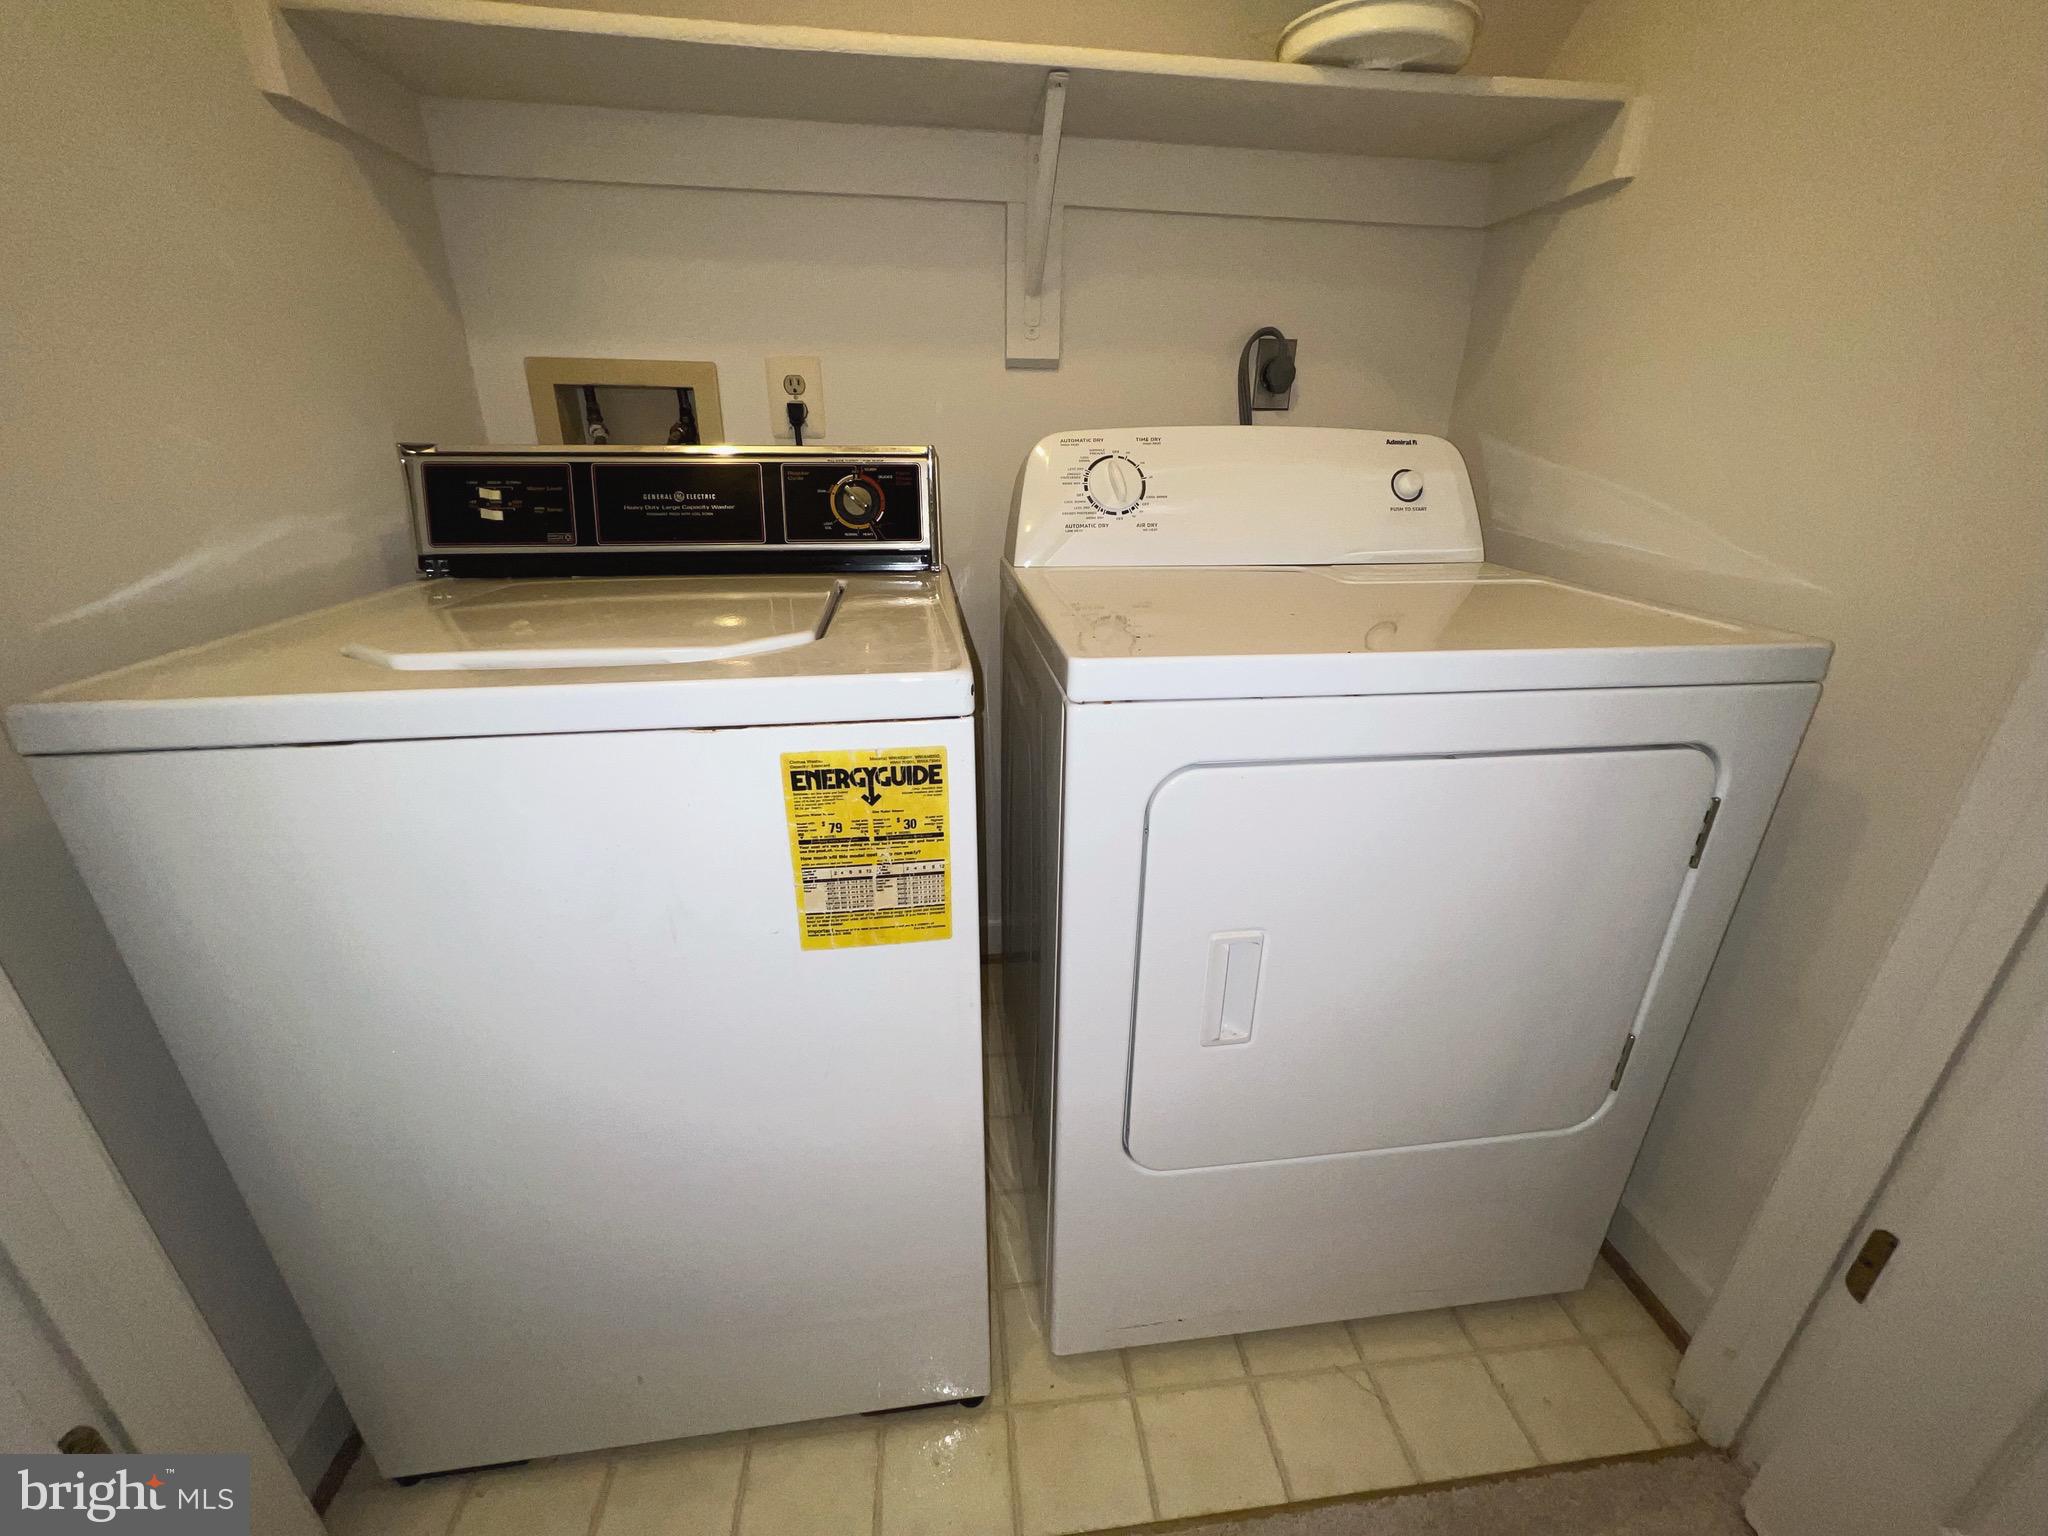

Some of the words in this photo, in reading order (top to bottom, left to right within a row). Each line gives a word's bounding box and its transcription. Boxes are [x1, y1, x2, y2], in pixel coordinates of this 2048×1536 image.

[790, 764, 943, 791] ENERGYGUIDE
[828, 822, 843, 834] 79
[903, 818, 917, 830] 30
